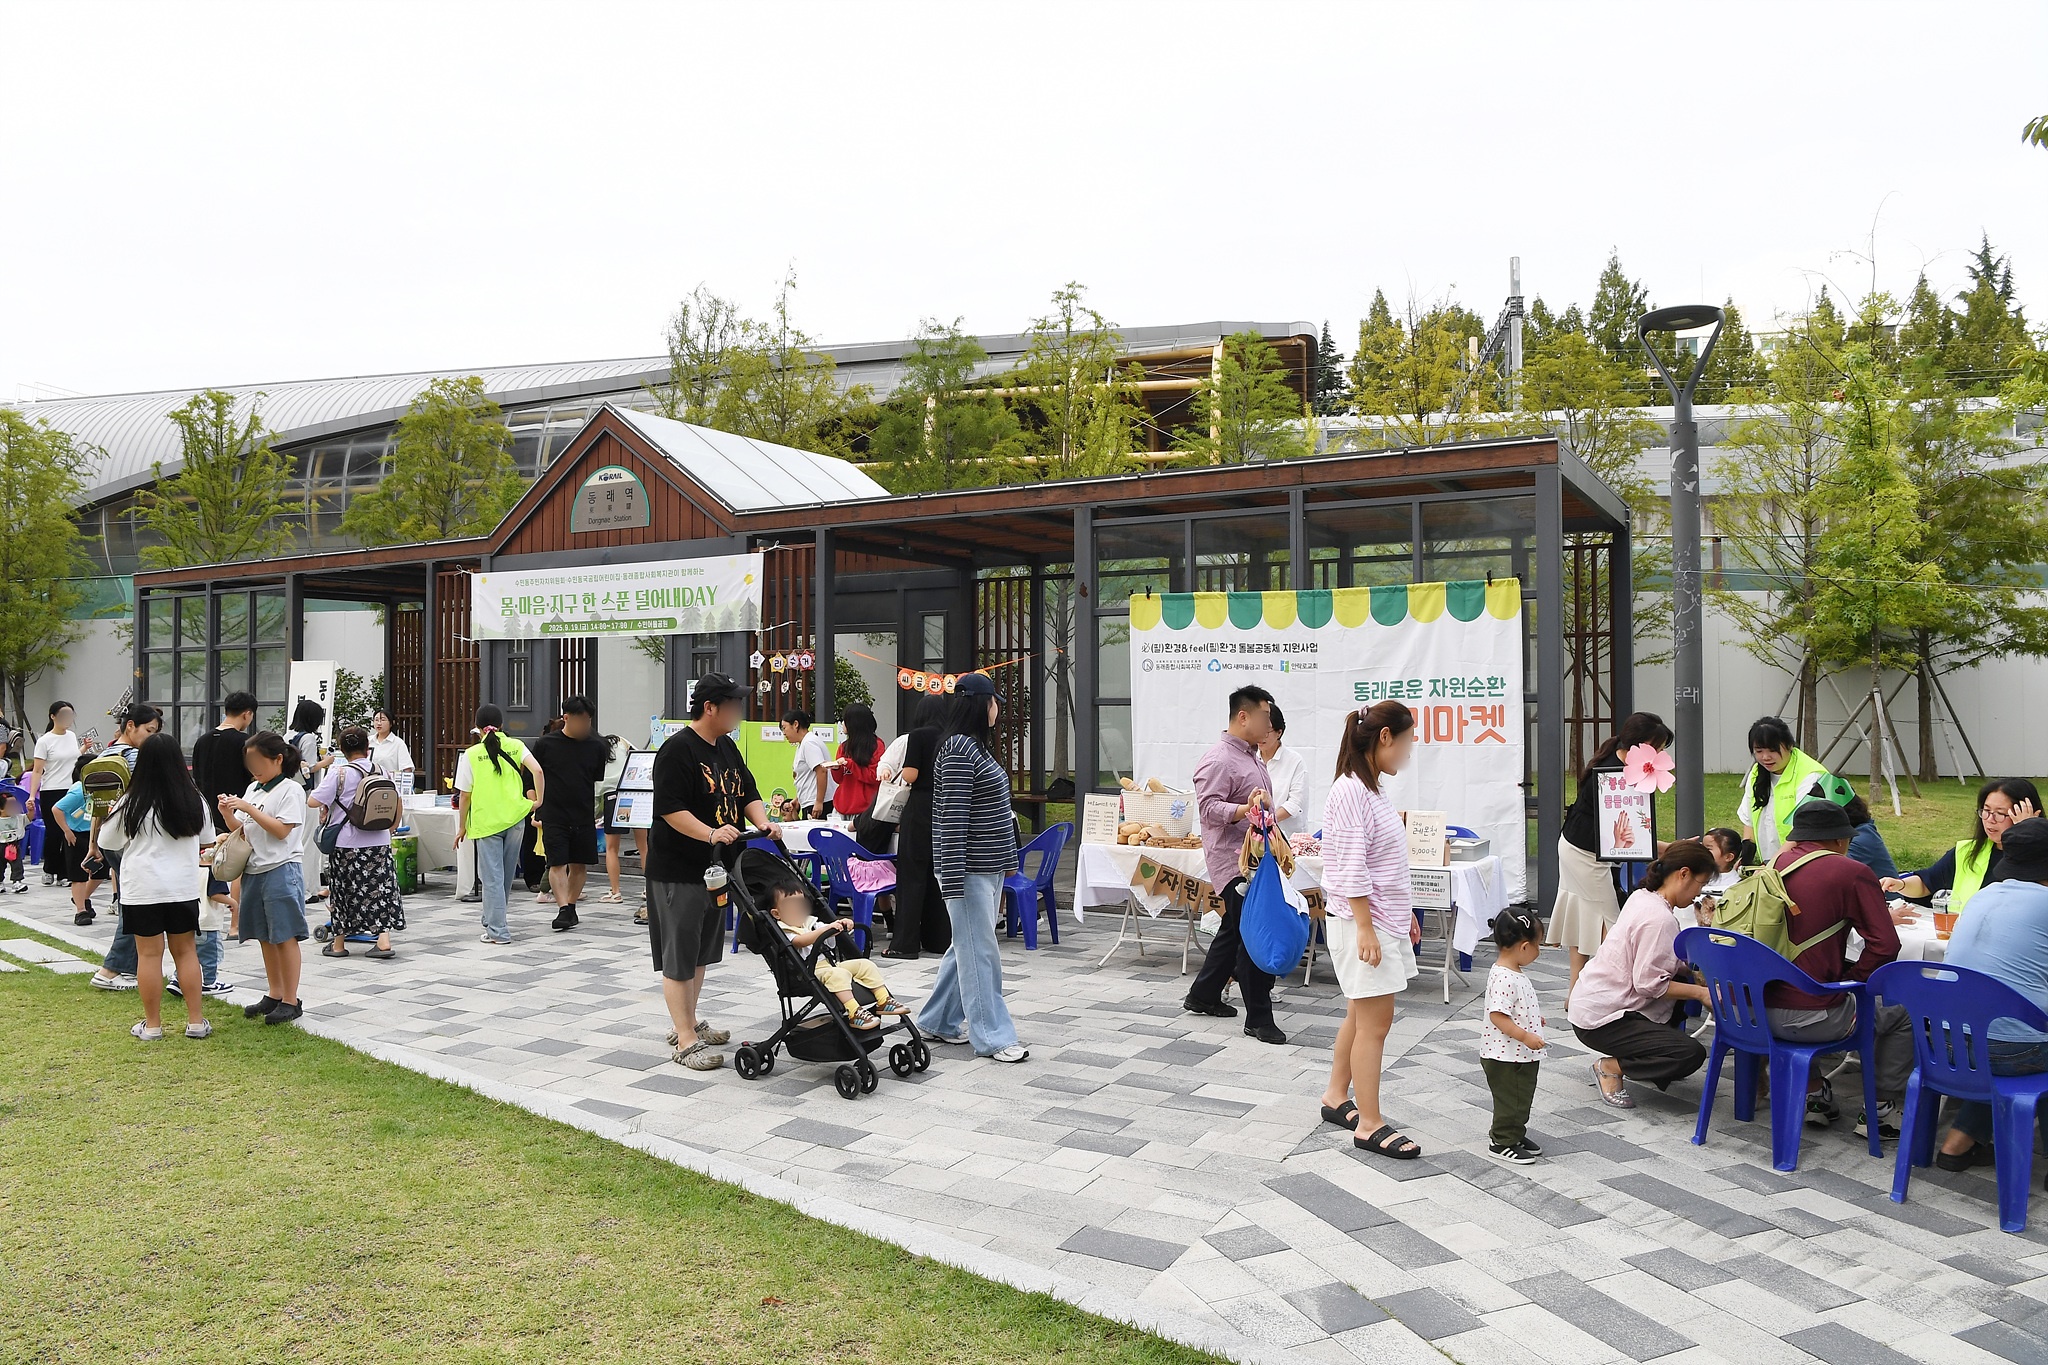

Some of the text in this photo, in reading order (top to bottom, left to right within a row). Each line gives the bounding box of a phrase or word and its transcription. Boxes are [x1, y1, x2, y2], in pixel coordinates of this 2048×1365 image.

[599, 473, 623, 481] KORAIL
[588, 487, 633, 505] 동래역
[582, 592, 597, 613] 한
[601, 591, 630, 612] 스푼
[1283, 642, 1318, 653] 지원사업
[1222, 662, 1233, 670] MG
[1354, 675, 1507, 702] 동래로운 자원순환
[1411, 704, 1507, 744] 리마켓
[1604, 795, 1644, 809] 물들이기
